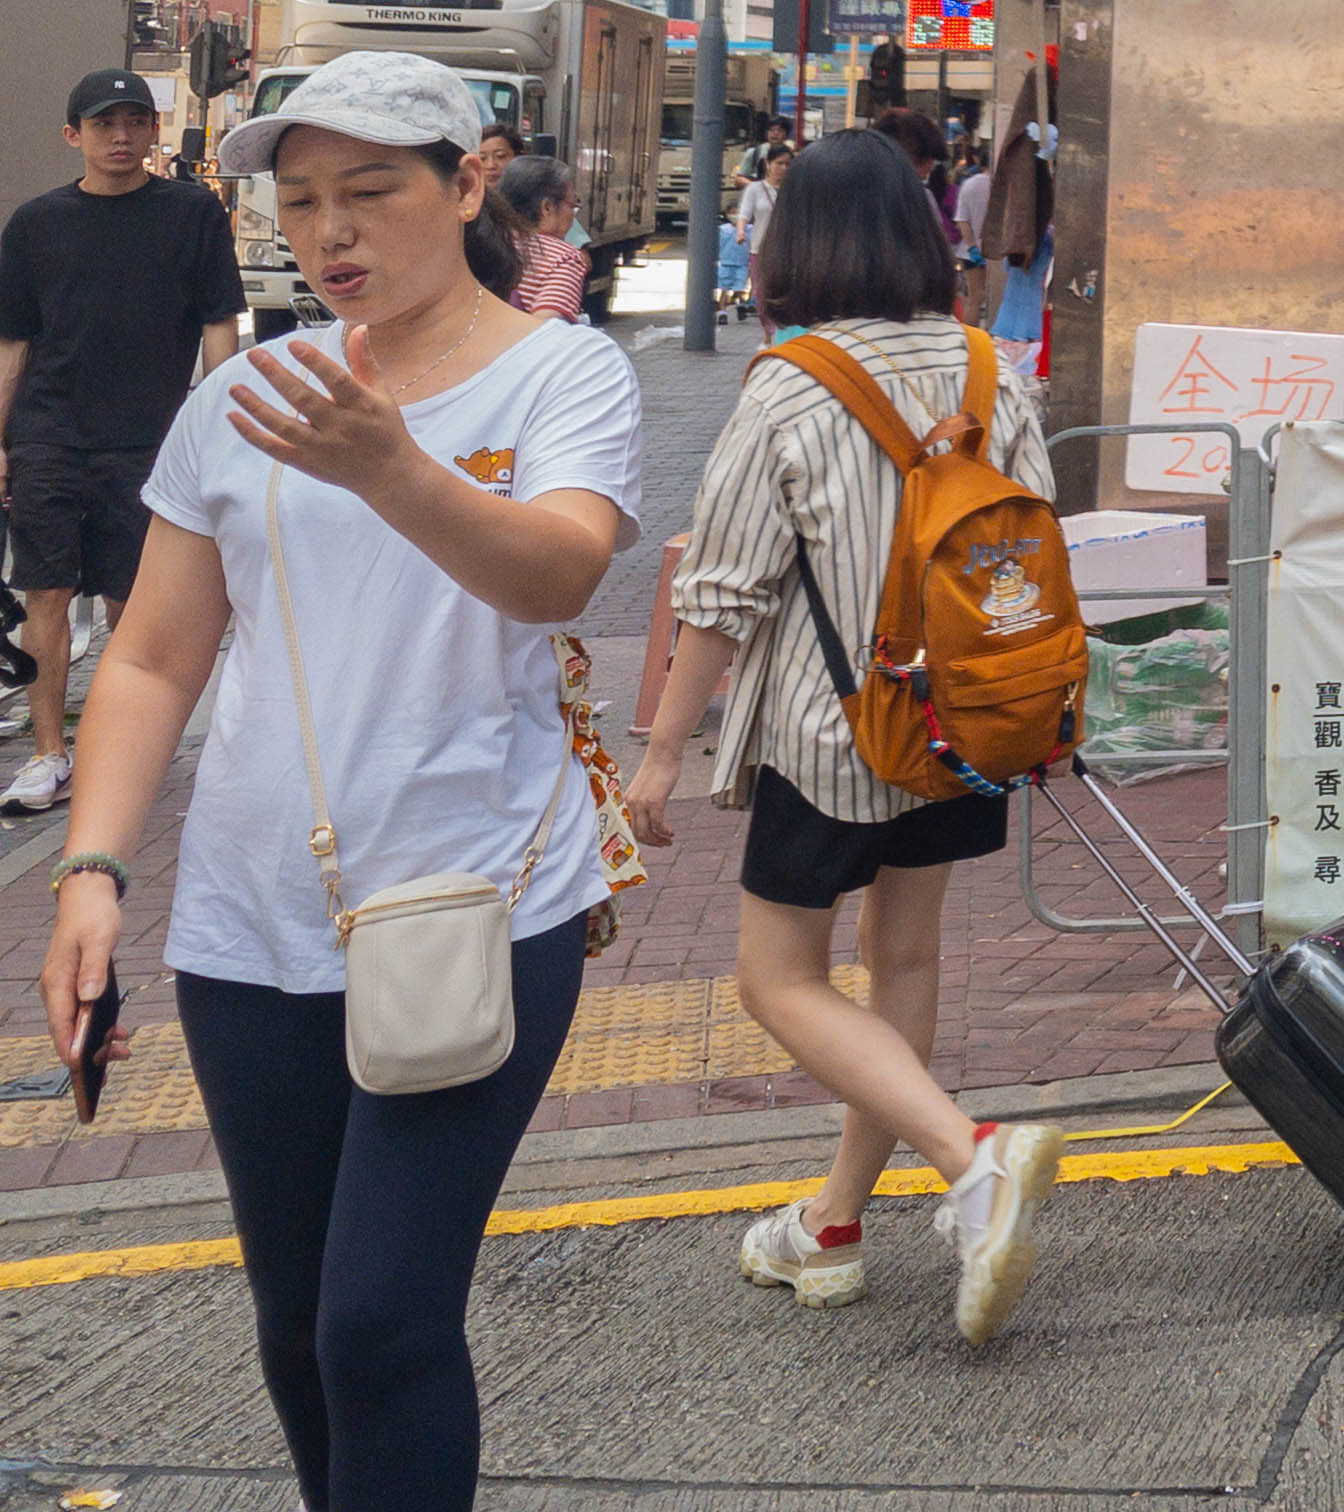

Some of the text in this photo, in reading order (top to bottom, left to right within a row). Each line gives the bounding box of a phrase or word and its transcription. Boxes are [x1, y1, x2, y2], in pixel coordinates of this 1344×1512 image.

[366, 9, 462, 23] THERMO KING
[1157, 334, 1336, 424] 全场
